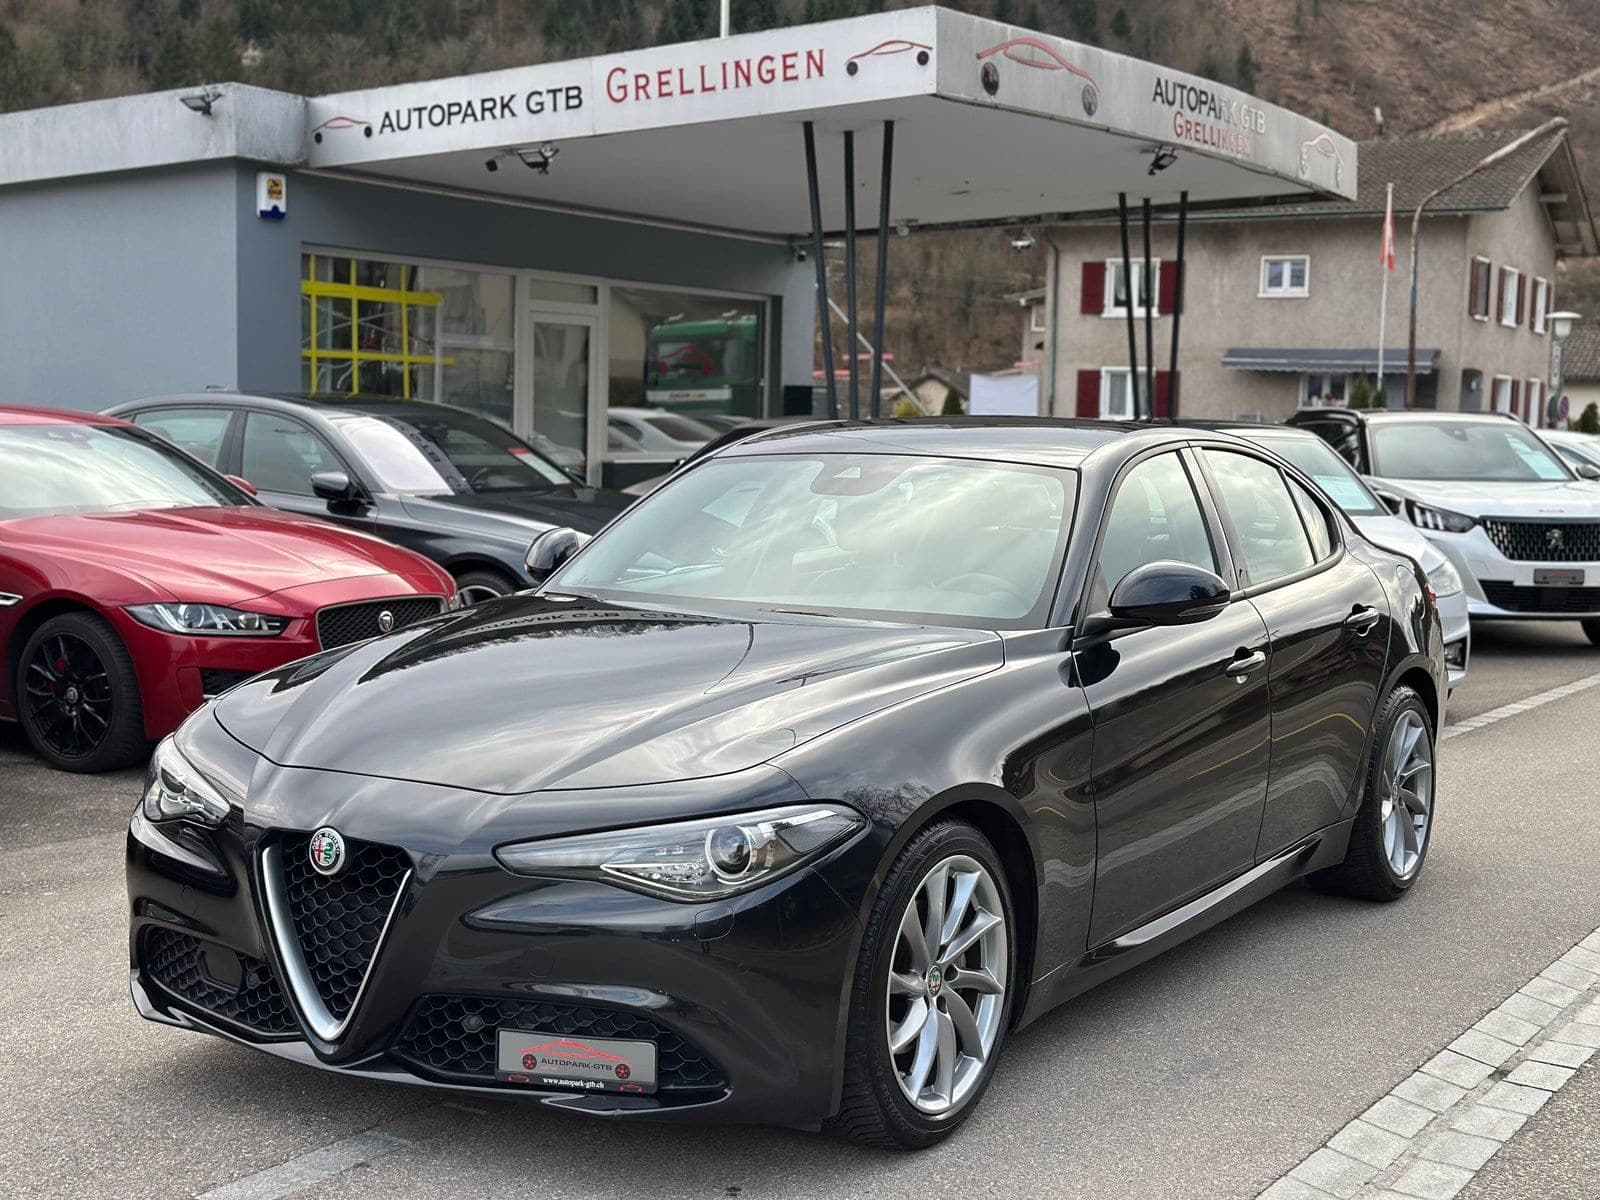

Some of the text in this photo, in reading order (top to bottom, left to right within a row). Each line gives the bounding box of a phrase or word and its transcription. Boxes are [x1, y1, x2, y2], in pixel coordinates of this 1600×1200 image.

[606, 48, 825, 104] GRELLINGEN
[379, 86, 583, 135] AUTOPARK GTB
[1152, 77, 1265, 135] AUTOPARK GTB
[1173, 111, 1251, 157] GRELLINGEN
[541, 1058, 613, 1071] AUTOPARK-GTB
[543, 1077, 605, 1089] www.autopark-gtb.ch
